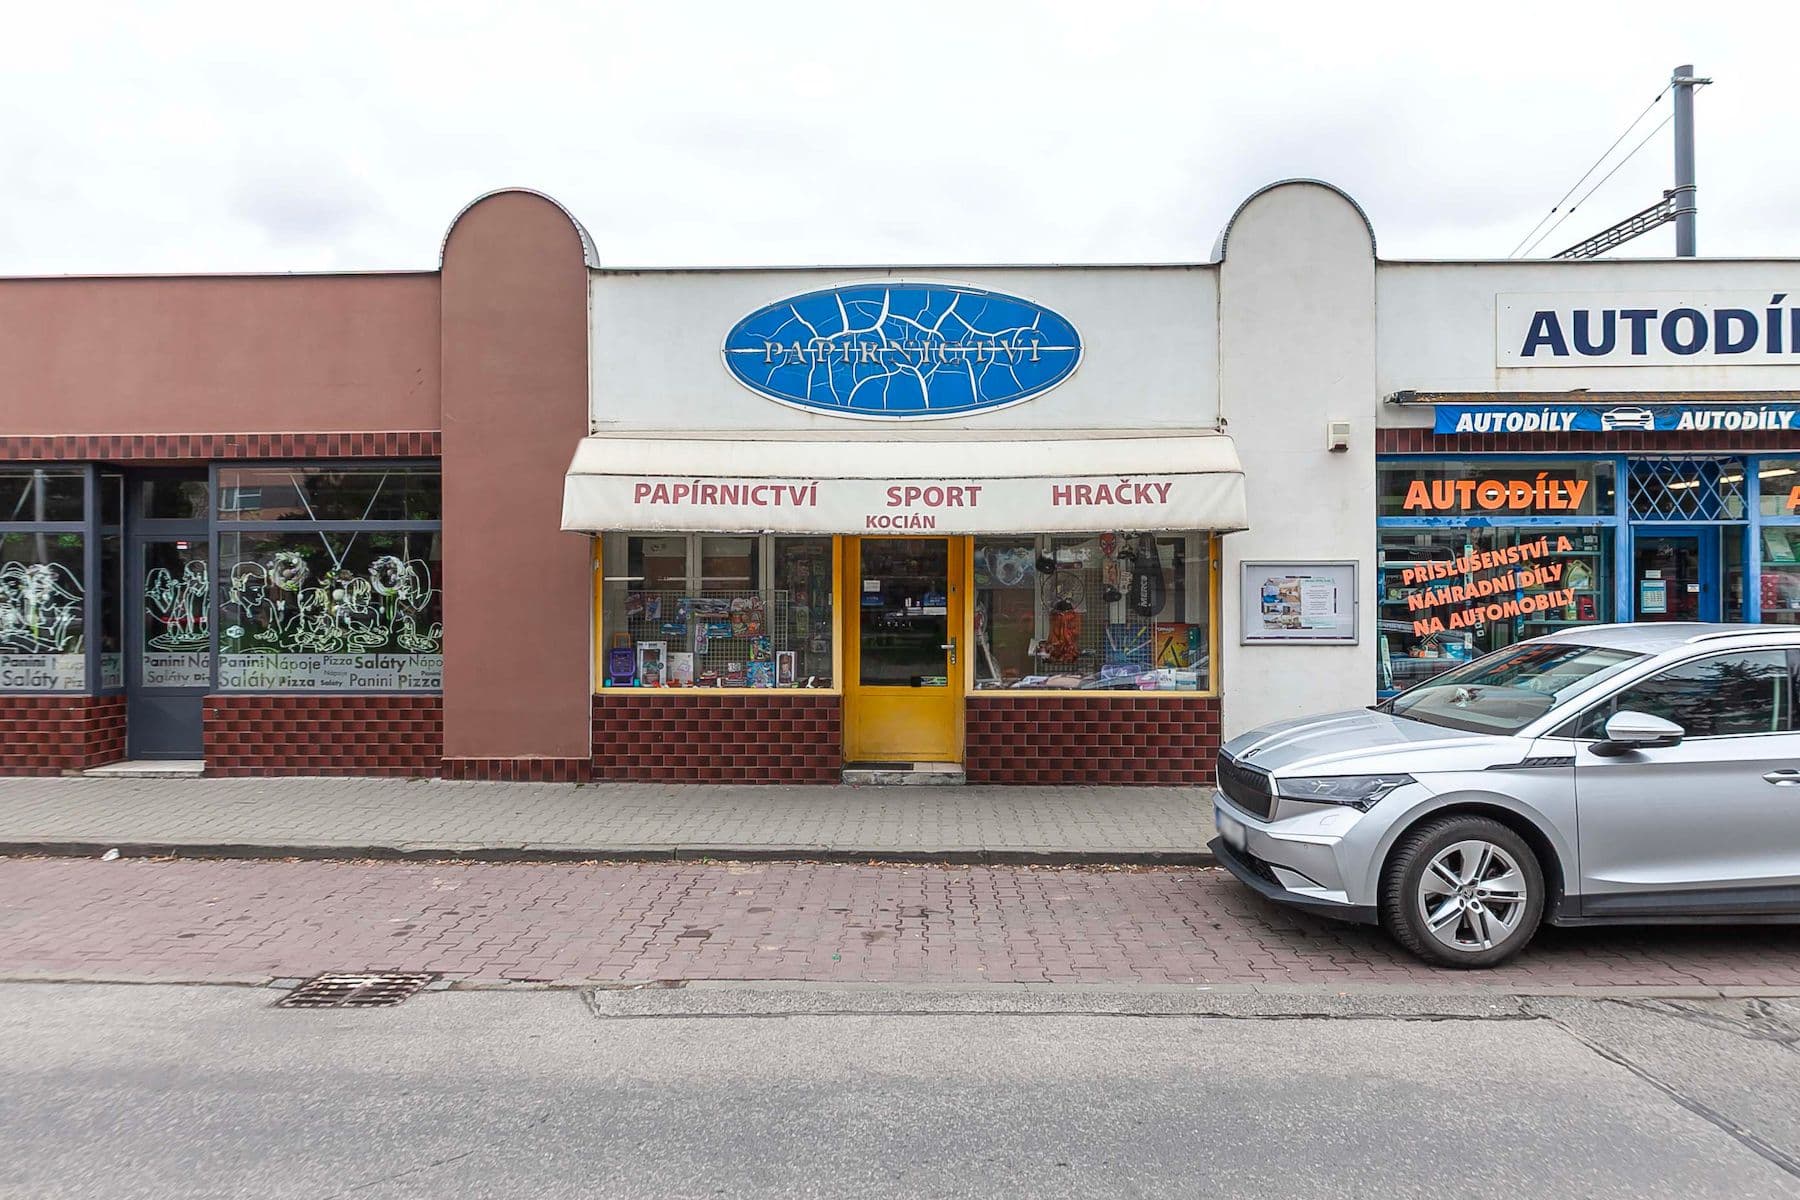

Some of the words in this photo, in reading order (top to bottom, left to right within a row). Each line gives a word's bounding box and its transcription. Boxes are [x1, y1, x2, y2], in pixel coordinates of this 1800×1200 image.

[1456, 408, 1577, 432] AUTODÍLY
[1677, 407, 1796, 431] AUTODÍLY
[634, 480, 820, 506] PAPÍRNICTVÍ
[886, 486, 982, 507] SPORT
[1052, 479, 1172, 506] HRAČKY
[1403, 472, 1588, 510] AUTODÍLY
[866, 513, 936, 529] KOCIÁN
[1557, 535, 1573, 553] A
[1407, 569, 1515, 611] NÁHRADNÍ
[1520, 562, 1563, 589] DÍLY
[1413, 616, 1445, 637] NA
[1449, 588, 1576, 630] AUTOMOBILY
[219, 655, 264, 667] Panini
[266, 653, 321, 673] Nápoje
[323, 656, 352, 665] Pizza
[355, 653, 407, 672] Saláty
[2, 668, 58, 689] Saláty
[219, 668, 276, 688] Saláty
[279, 675, 316, 687] Pizza
[350, 673, 392, 687] Panini
[398, 674, 441, 688] Pizza
